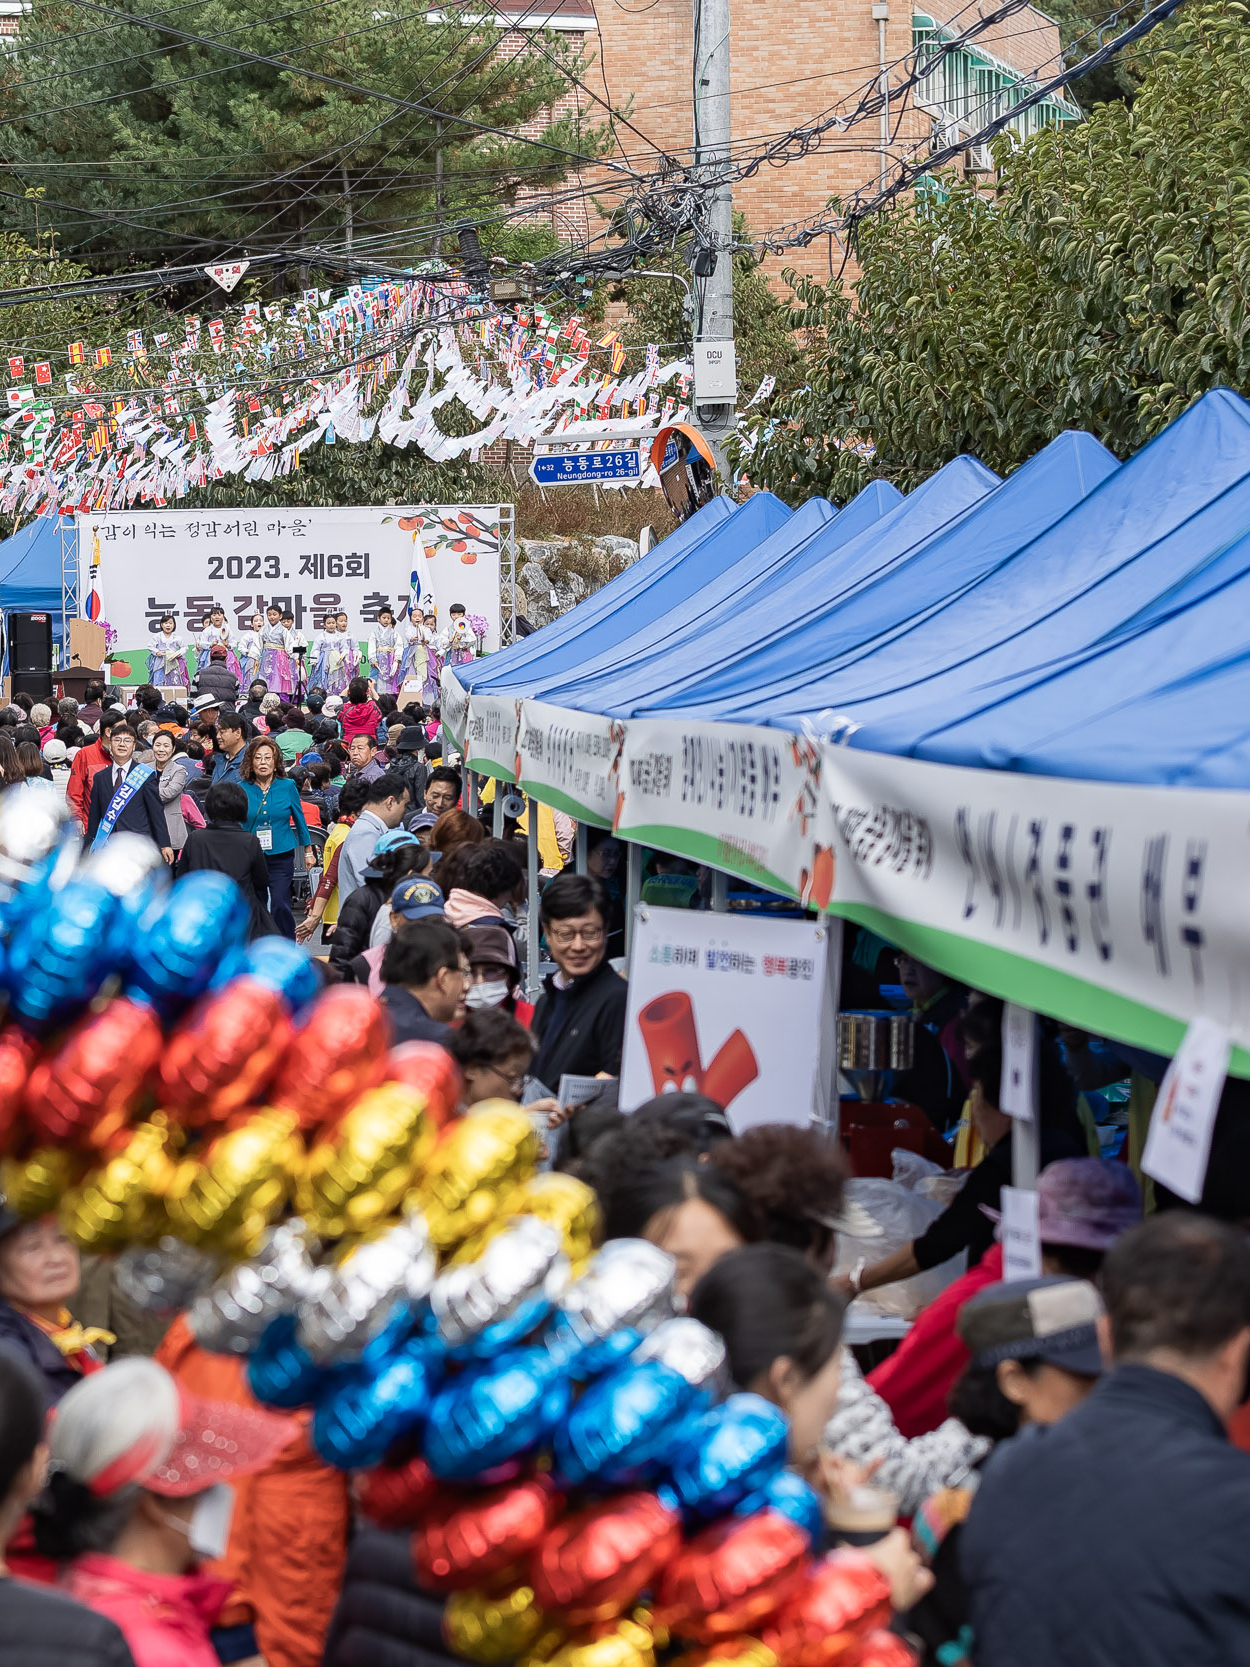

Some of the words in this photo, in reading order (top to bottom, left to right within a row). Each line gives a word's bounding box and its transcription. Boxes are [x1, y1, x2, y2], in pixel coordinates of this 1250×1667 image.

[562, 453, 637, 472] 능동로26길
[557, 470, 613, 481] Neungdong-ro
[616, 467, 638, 478] 26-gil
[144, 521, 177, 540] 익는
[183, 519, 259, 538] 정감어린
[207, 555, 290, 581] 2023.
[298, 552, 370, 580] 제6회
